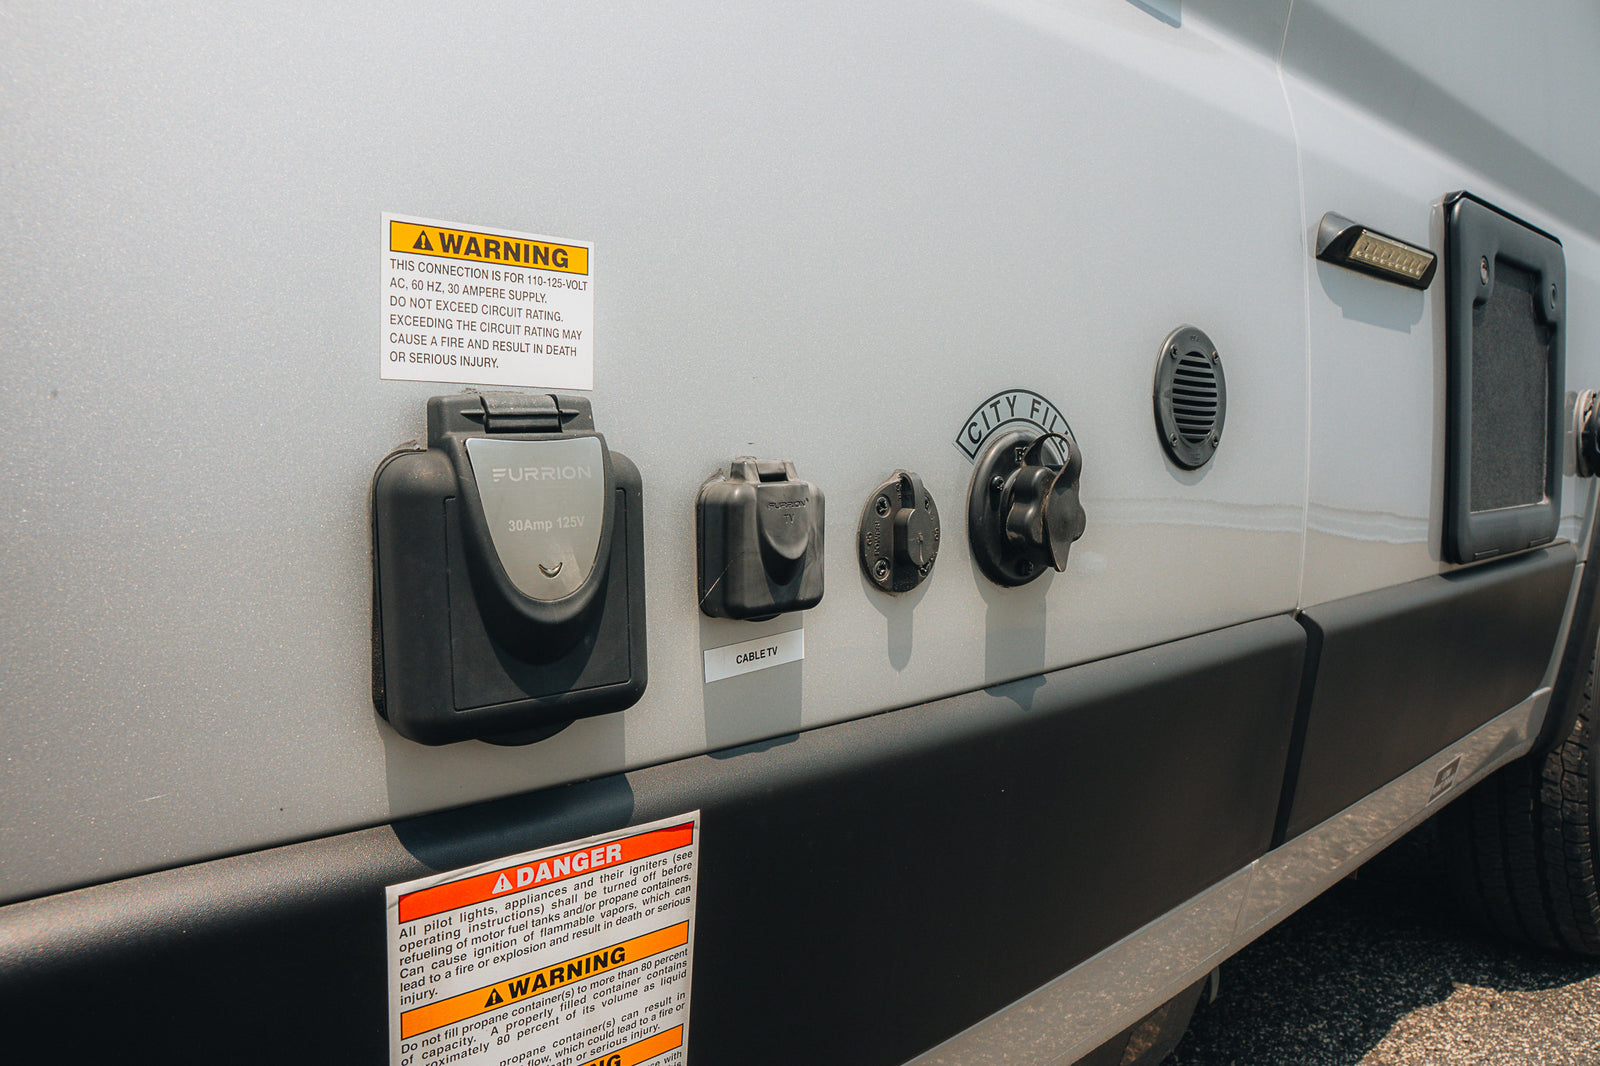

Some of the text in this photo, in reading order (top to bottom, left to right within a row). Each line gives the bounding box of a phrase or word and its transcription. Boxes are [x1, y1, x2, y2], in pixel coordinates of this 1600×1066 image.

[439, 232, 569, 268] WARNING
[390, 258, 588, 291] THIS CONNECTION IS FOR 110-125-VOLT
[390, 277, 547, 303] AC, 60 HZ, 30 AMPERE SUPPLY.
[390, 295, 564, 322] DO NOT EXCEED CIRCUIT RATING.
[390, 314, 582, 340] EXCEEDING THE CIRCUIT RATING MAY
[390, 332, 577, 356] CAUSE A FIRE AND RESULT IN DEATH
[390, 351, 499, 368] OR SERIOUS INJURY.
[967, 395, 1017, 445] CITY
[492, 466, 592, 482] FURRION
[508, 516, 585, 532] 30Amp 125V
[736, 646, 778, 665] CABLE TV
[516, 843, 621, 888] DANGER
[399, 851, 693, 939] All pilot lights, appliances and their igniters (see
[399, 862, 692, 953] operating instructions) shall be turned off before
[399, 874, 691, 966] refueling of motor fuel tanks and/or propane containers.
[400, 966, 424, 979] Can
[431, 953, 467, 970] cause
[474, 938, 517, 958] ignition
[523, 931, 534, 942] of
[540, 914, 595, 937] flammable
[642, 891, 670, 906] which
[675, 885, 691, 895] can
[400, 896, 691, 992] lead to a fire or explosion and result in death or serious
[508, 947, 626, 999] WARNING
[400, 988, 438, 1006] injury.
[401, 960, 687, 1066] of capacity. A properly filled container contains
[402, 948, 688, 1054] Do not fill propane container(s) to more than 80 percent
[497, 1034, 510, 1046] 80
[517, 1016, 559, 1040] percent
[566, 1010, 576, 1021] of
[583, 1004, 596, 1015] its
[602, 989, 639, 1007] volume
[644, 983, 655, 992] as
[661, 969, 687, 986] liquid
[500, 992, 686, 1066] propane container(s) can result in
[555, 1041, 585, 1058] which
[588, 1030, 614, 1047] could
[617, 1020, 637, 1034] lead
[640, 1017, 649, 1026] to
[651, 1014, 657, 1022] a
[659, 1007, 673, 1018] fire
[676, 1002, 685, 1011] or
[576, 1051, 587, 1061] or
[590, 1036, 628, 1056] serious
[631, 1023, 660, 1040] injury.
[664, 1051, 682, 1064] with
